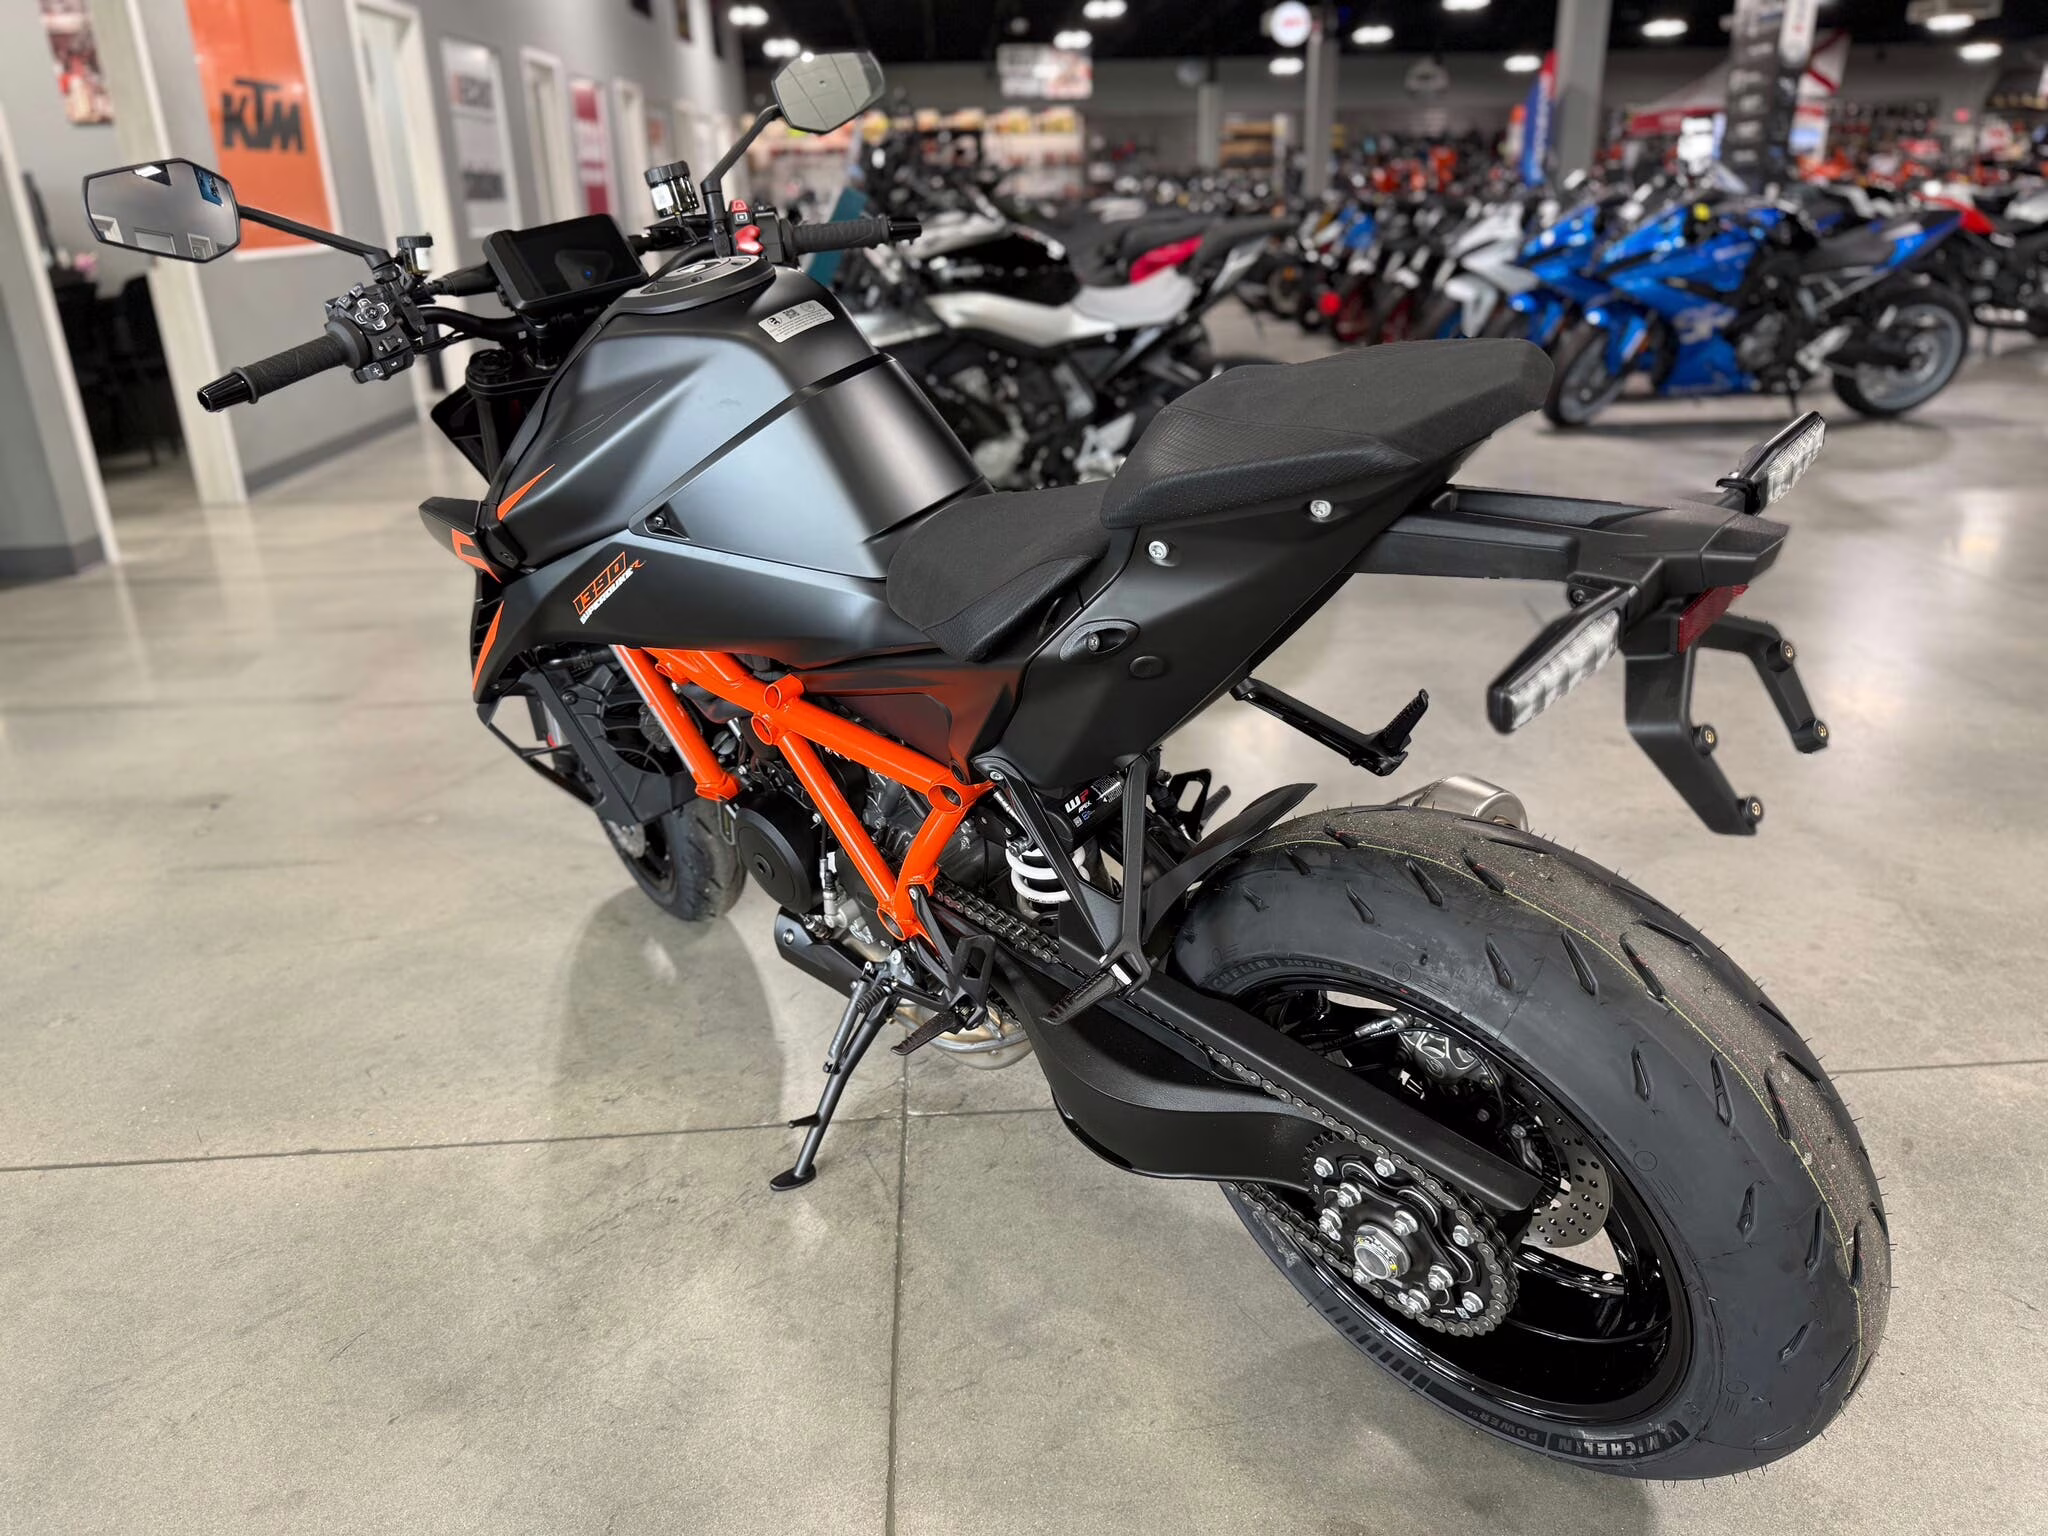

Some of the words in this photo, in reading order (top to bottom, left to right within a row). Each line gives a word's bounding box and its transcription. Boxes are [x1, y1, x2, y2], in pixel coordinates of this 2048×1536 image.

[222, 77, 305, 153] KTM
[573, 551, 627, 616] 1390
[1064, 789, 1089, 813] WP
[1480, 1409, 1538, 1441] POWER
[1557, 1434, 1661, 1456] MICHELIN
